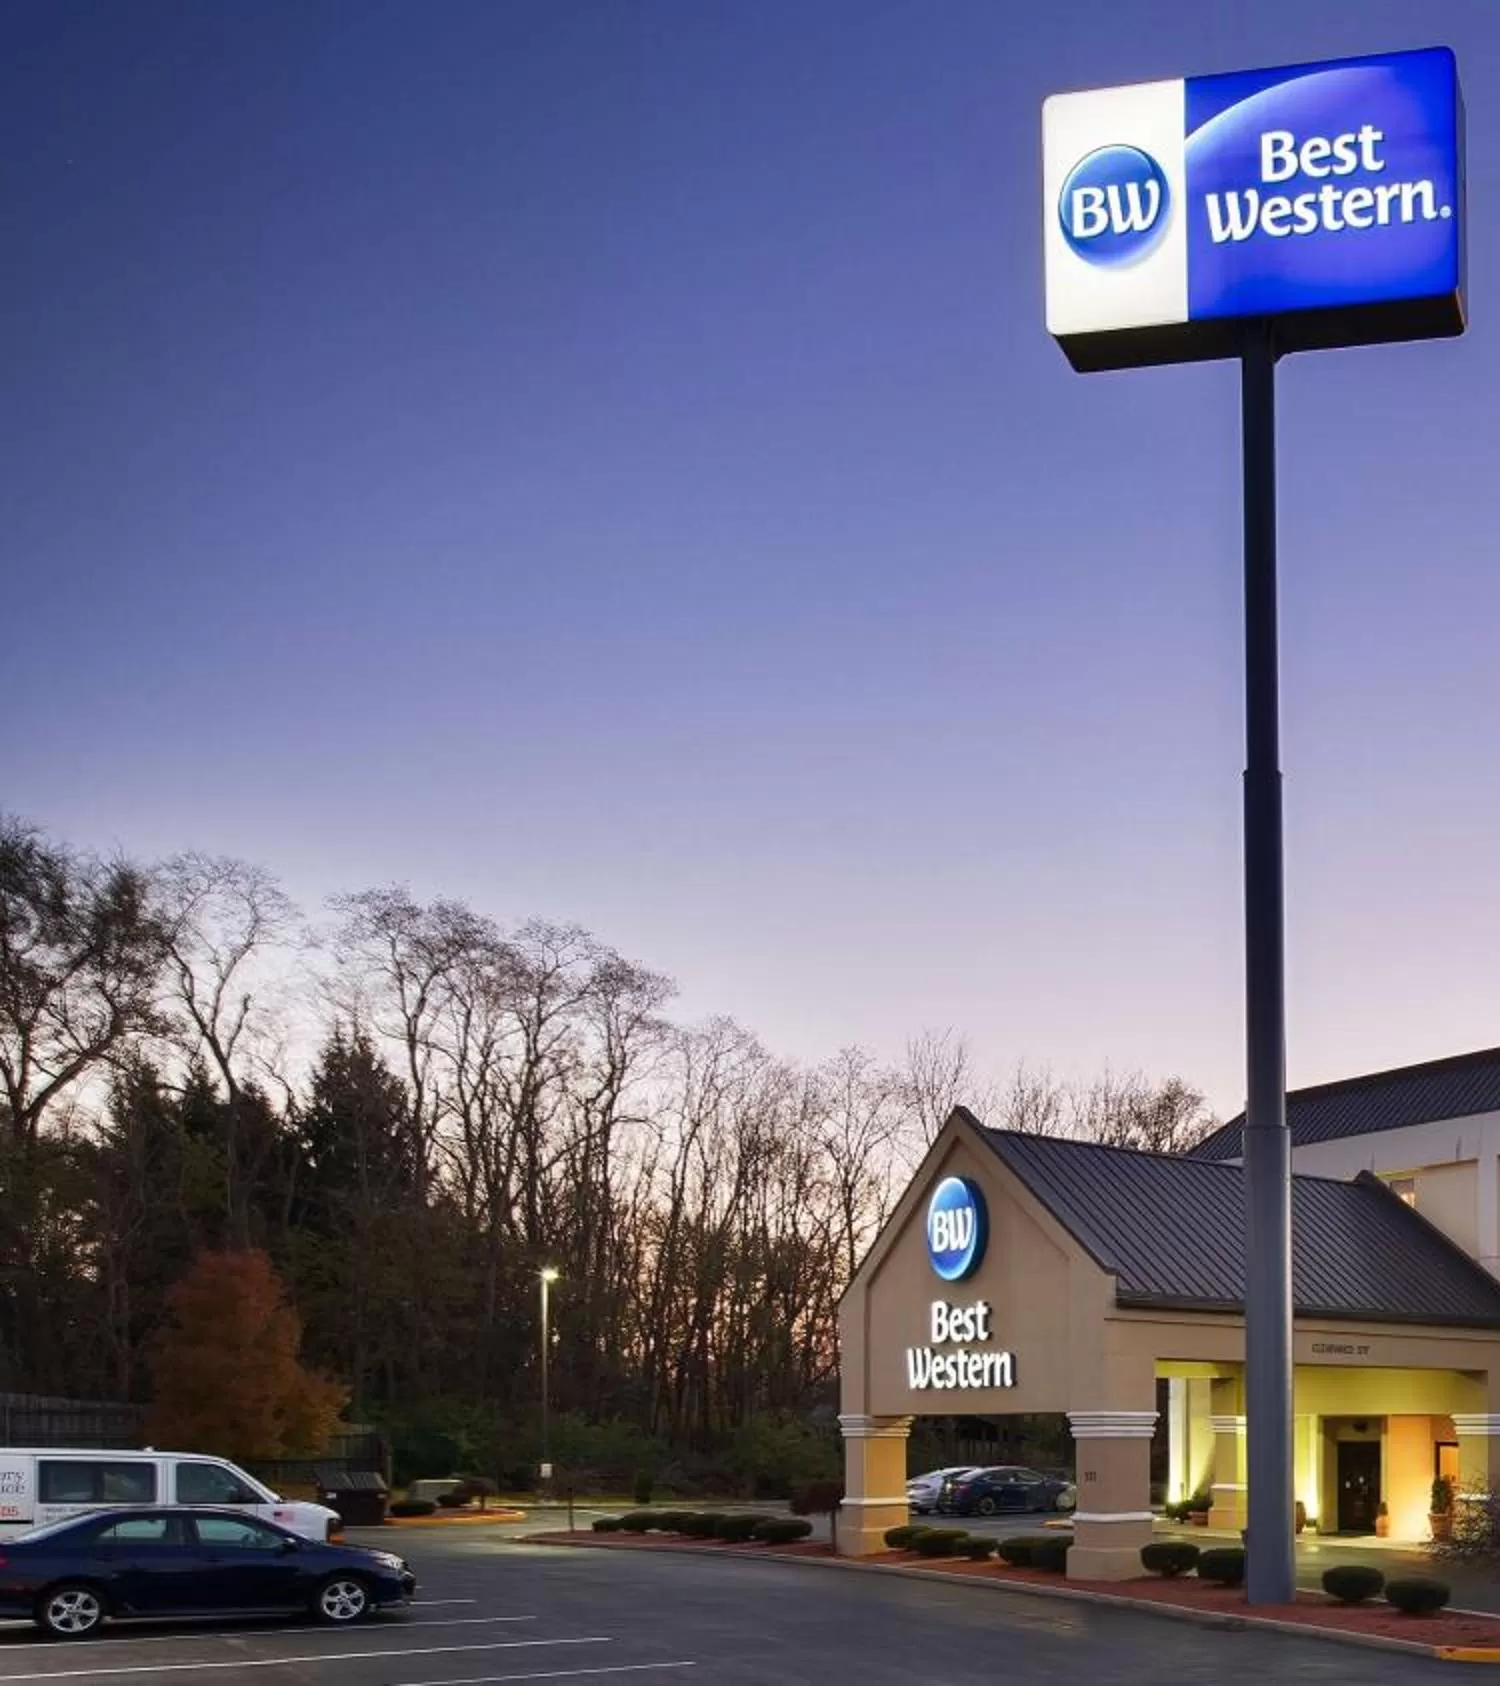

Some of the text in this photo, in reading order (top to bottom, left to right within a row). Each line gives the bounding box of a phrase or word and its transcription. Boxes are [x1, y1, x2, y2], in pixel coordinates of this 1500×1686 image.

[1260, 124, 1385, 183] Best
[1071, 178, 1161, 239] BW
[932, 1206, 973, 1253] BW
[931, 1300, 990, 1343] Best
[907, 1347, 1013, 1389] Western
